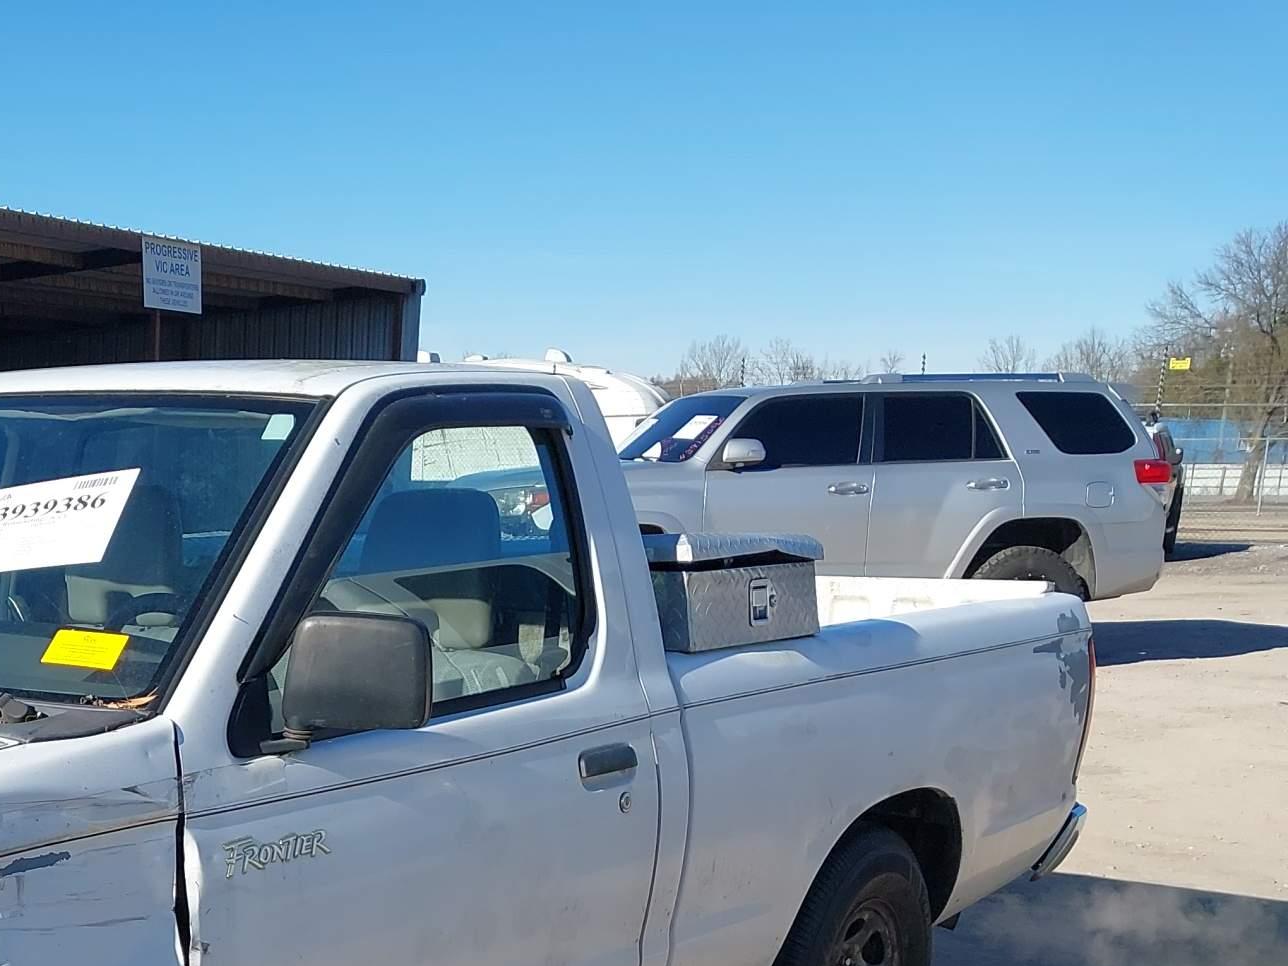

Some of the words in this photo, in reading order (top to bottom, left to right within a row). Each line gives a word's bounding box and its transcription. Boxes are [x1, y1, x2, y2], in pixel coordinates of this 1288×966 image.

[144, 241, 199, 263] PROGRESSIVE
[155, 260, 168, 274] VIC
[169, 263, 191, 277] AREA
[223, 829, 332, 878] FRONTIER
